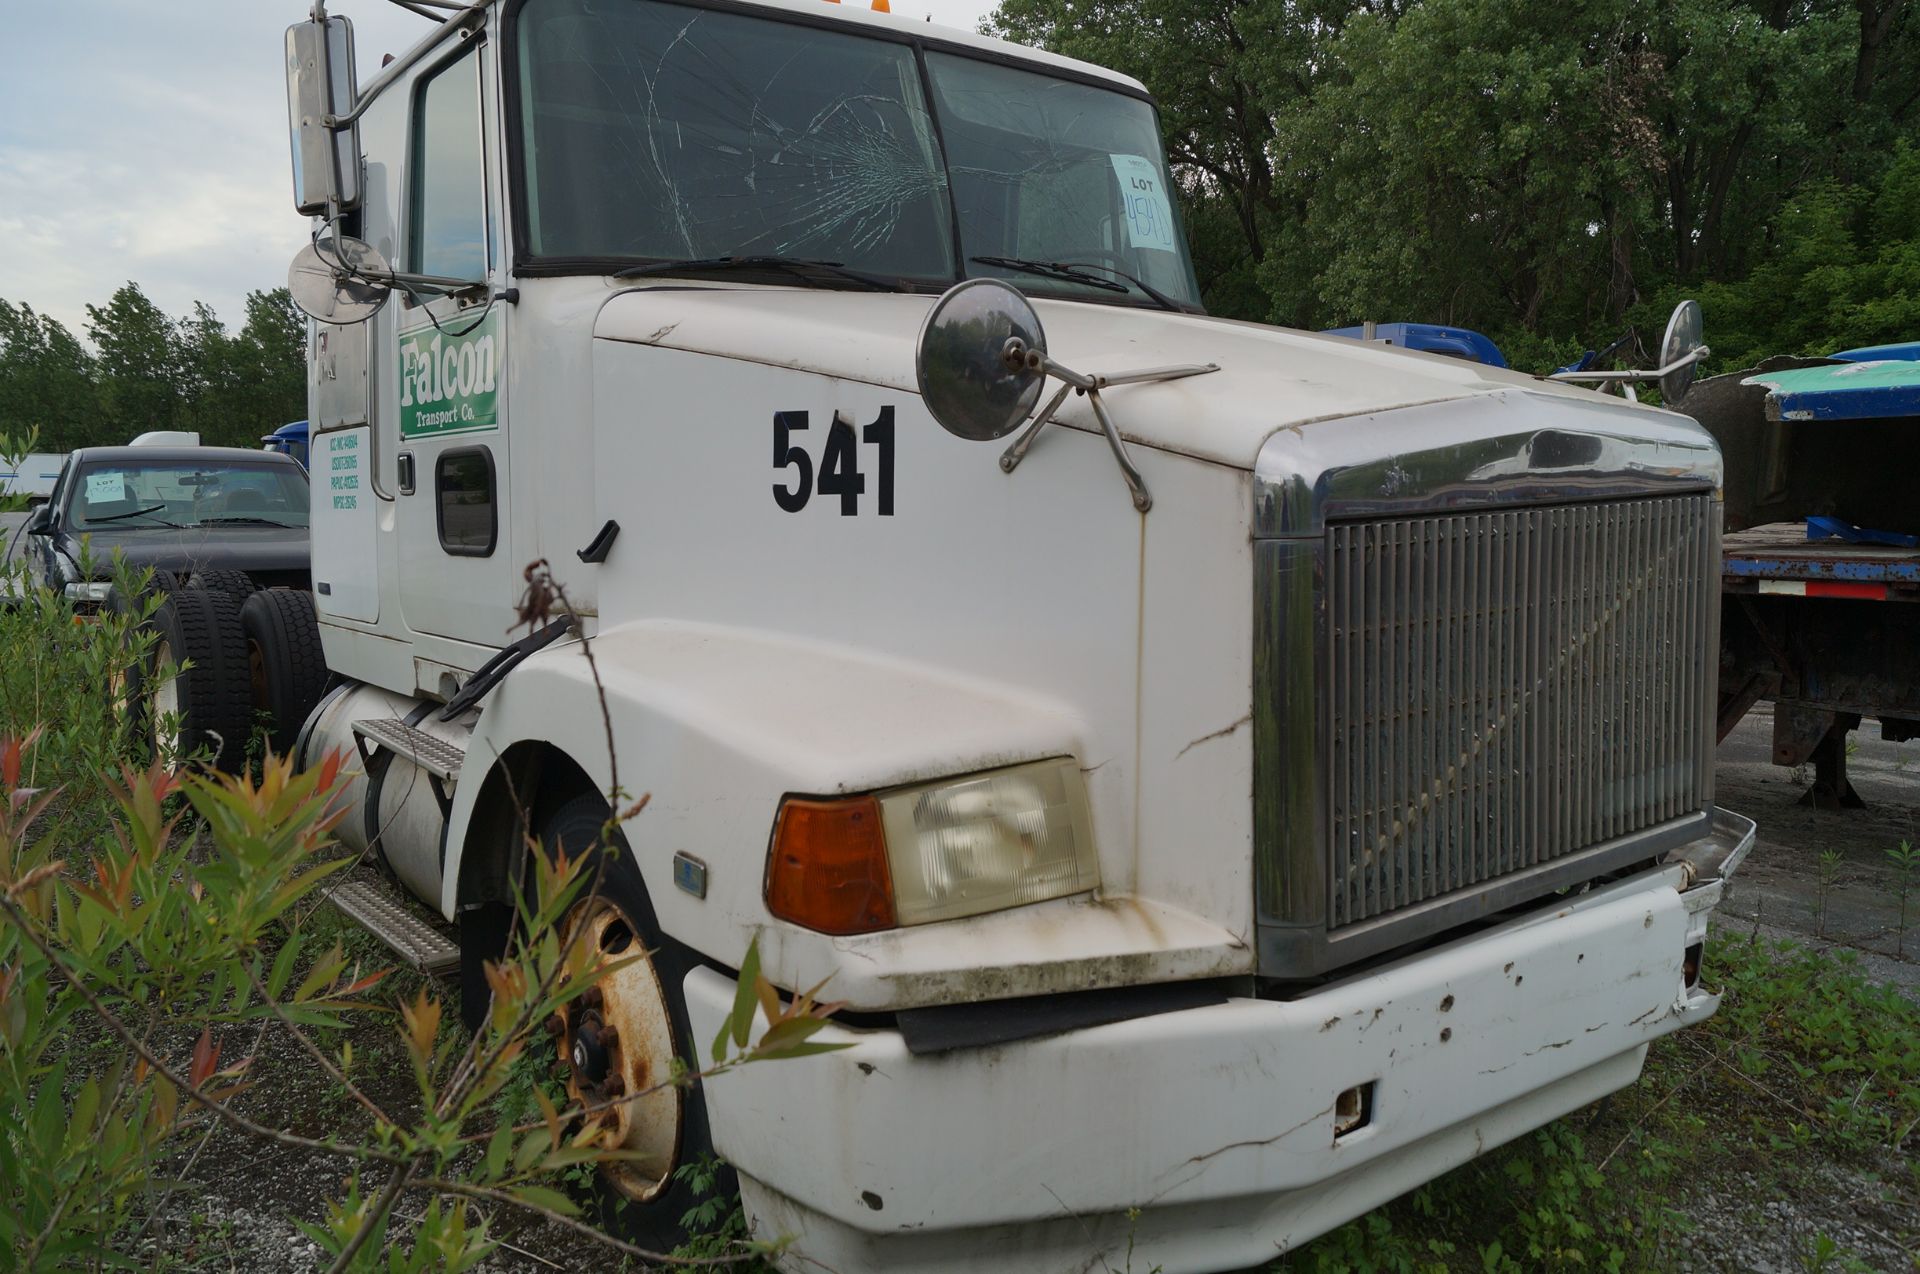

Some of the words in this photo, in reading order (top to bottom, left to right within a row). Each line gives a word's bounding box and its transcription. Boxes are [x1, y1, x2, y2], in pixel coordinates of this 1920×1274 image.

[1130, 176, 1153, 192] LOT
[401, 333, 495, 407] Falcon
[416, 405, 458, 427] Transport
[461, 403, 475, 421] Co.
[772, 405, 896, 517] 541
